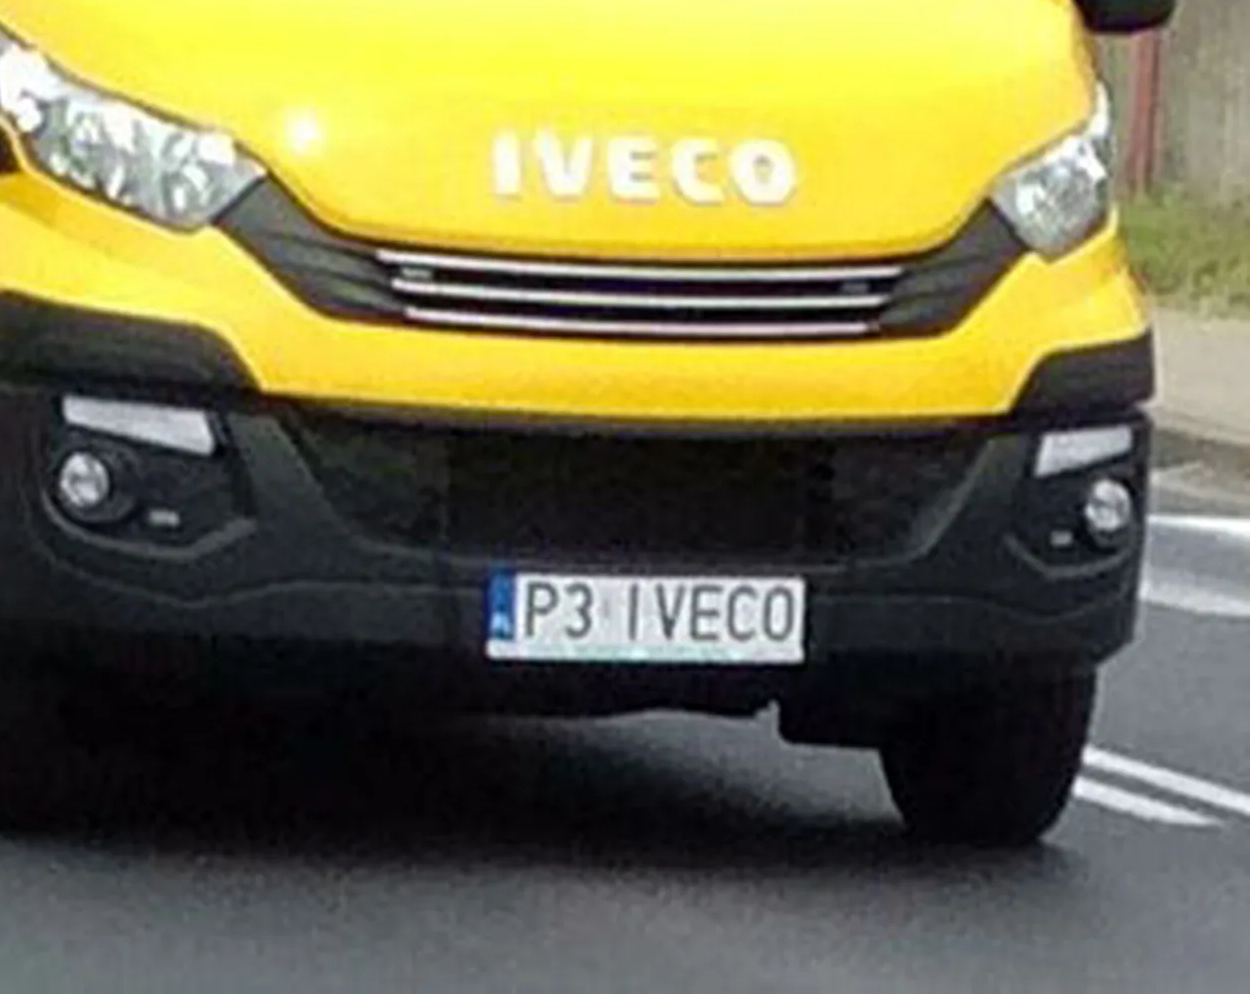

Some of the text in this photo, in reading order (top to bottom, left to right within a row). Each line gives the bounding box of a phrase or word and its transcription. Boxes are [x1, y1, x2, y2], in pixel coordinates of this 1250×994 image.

[492, 127, 798, 206] IVECO
[525, 580, 796, 642] P3 IVECO
